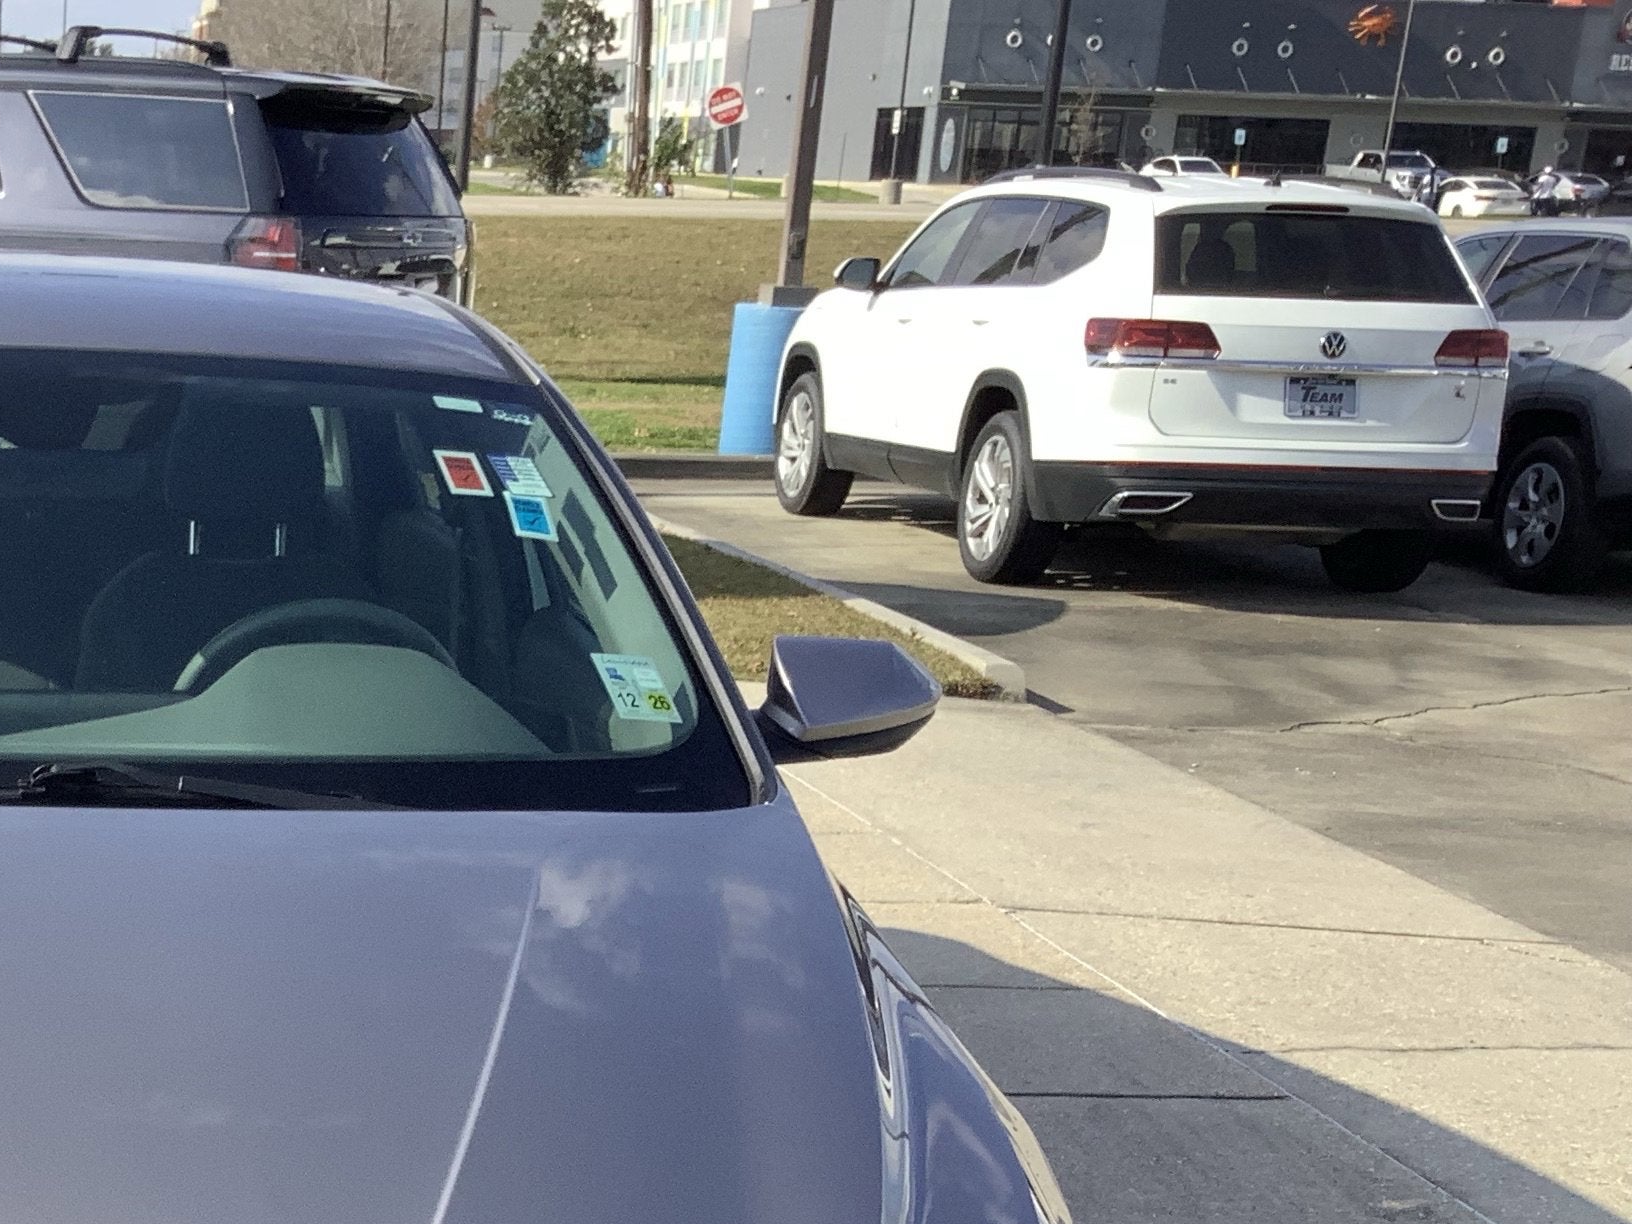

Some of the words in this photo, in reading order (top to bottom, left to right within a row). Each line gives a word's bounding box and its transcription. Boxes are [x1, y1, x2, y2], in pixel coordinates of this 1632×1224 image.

[1301, 386, 1344, 404] TEAM
[617, 692, 640, 708] 12
[648, 694, 671, 711] 26
